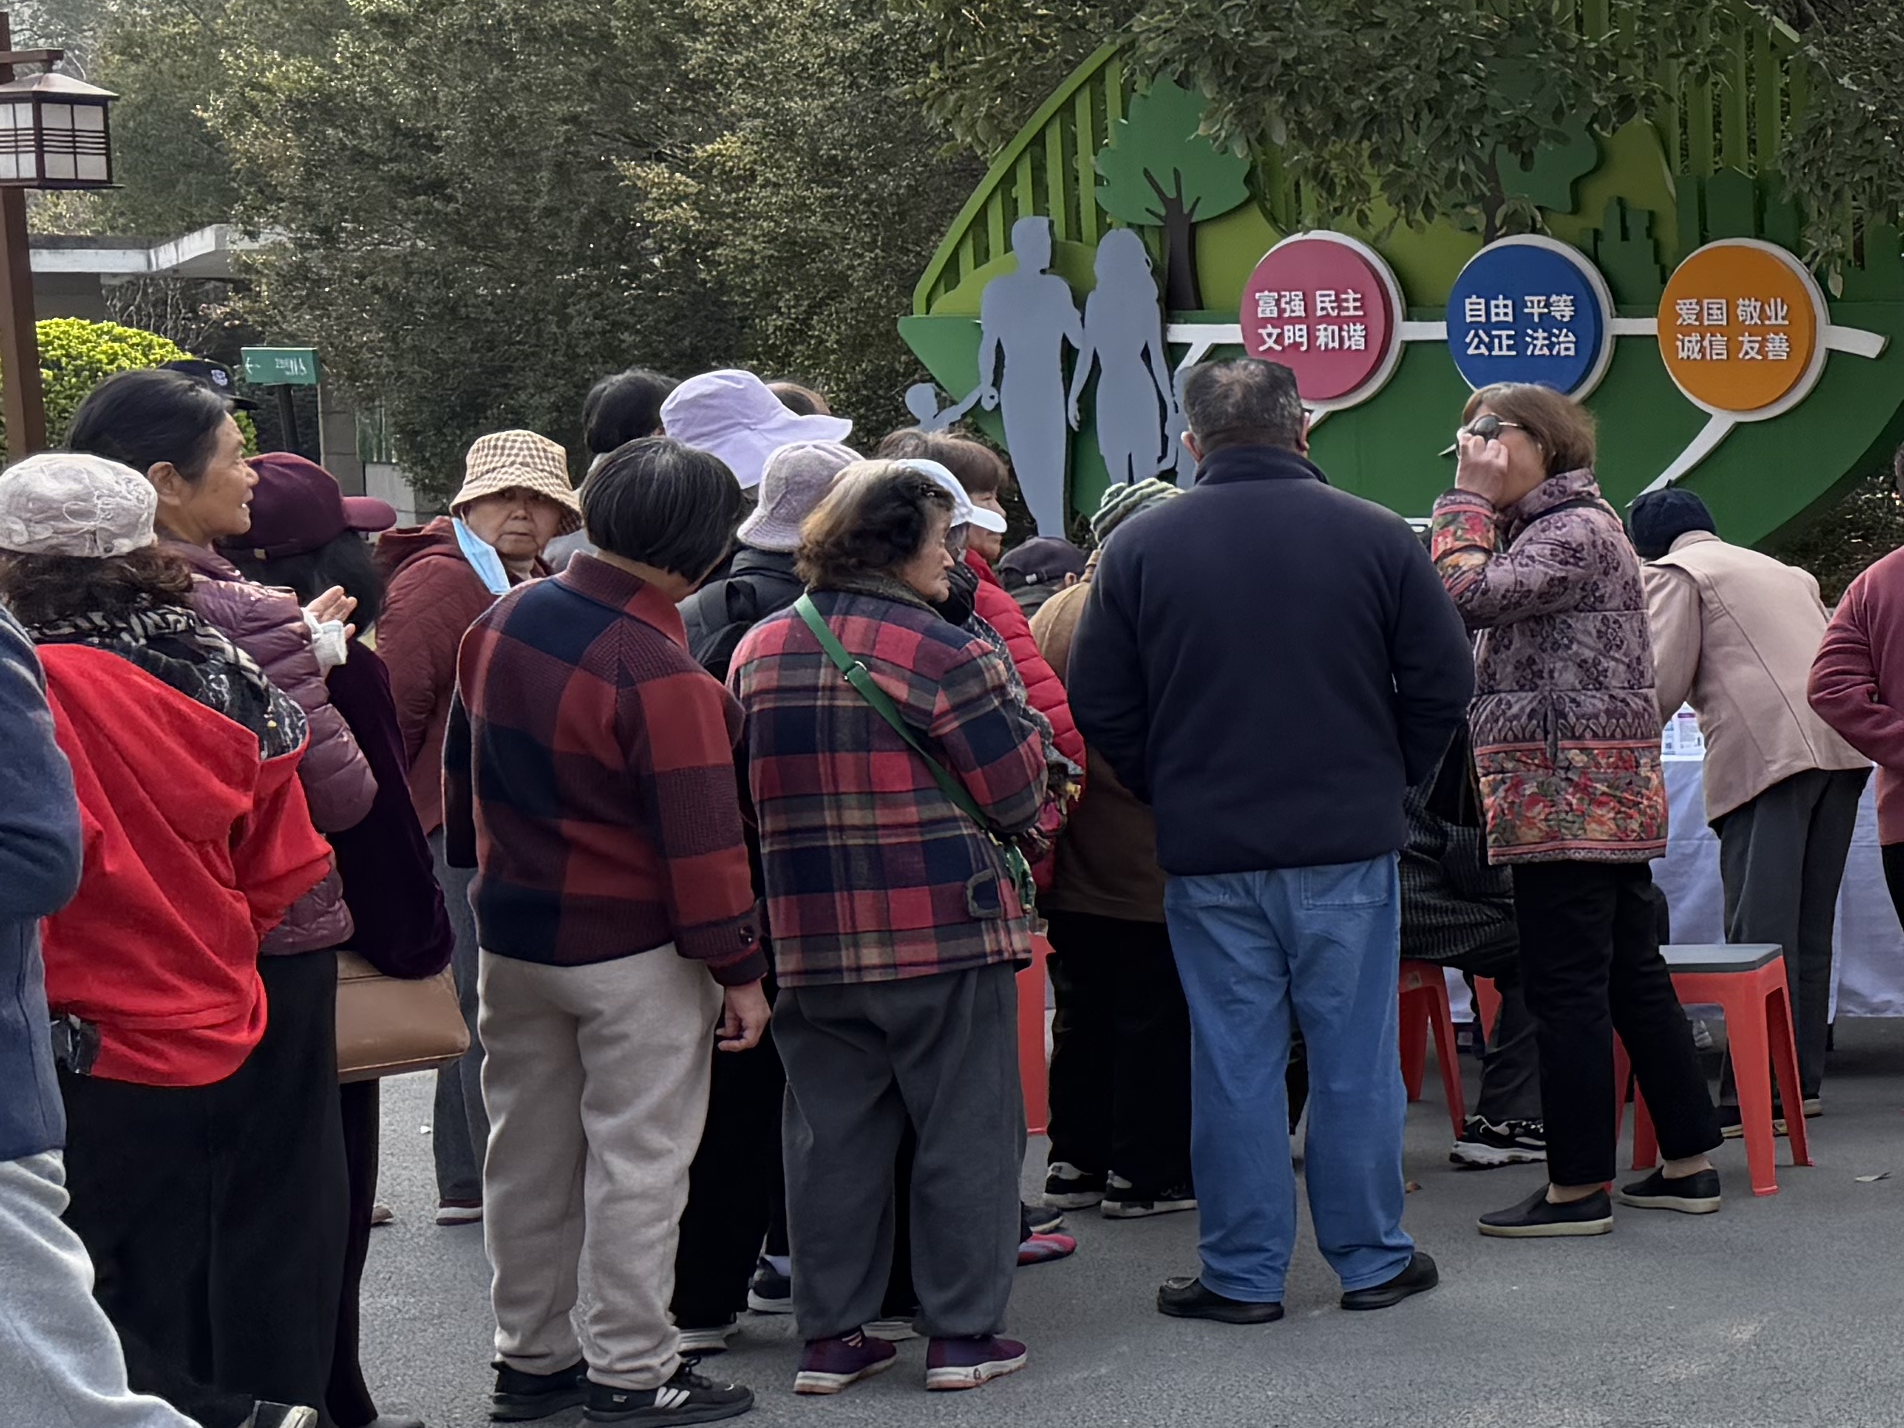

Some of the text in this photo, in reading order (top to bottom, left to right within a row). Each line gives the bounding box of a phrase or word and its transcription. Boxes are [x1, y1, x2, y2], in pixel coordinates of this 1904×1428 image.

[1255, 289, 1364, 318] 富强 民主
[1465, 294, 1575, 323] 自由 平等
[1675, 297, 1789, 326] 爱国 敬业
[1316, 323, 1366, 351] 和谐
[1465, 328, 1576, 356] 公正 法治
[1675, 332, 1790, 360] 诚信 友善
